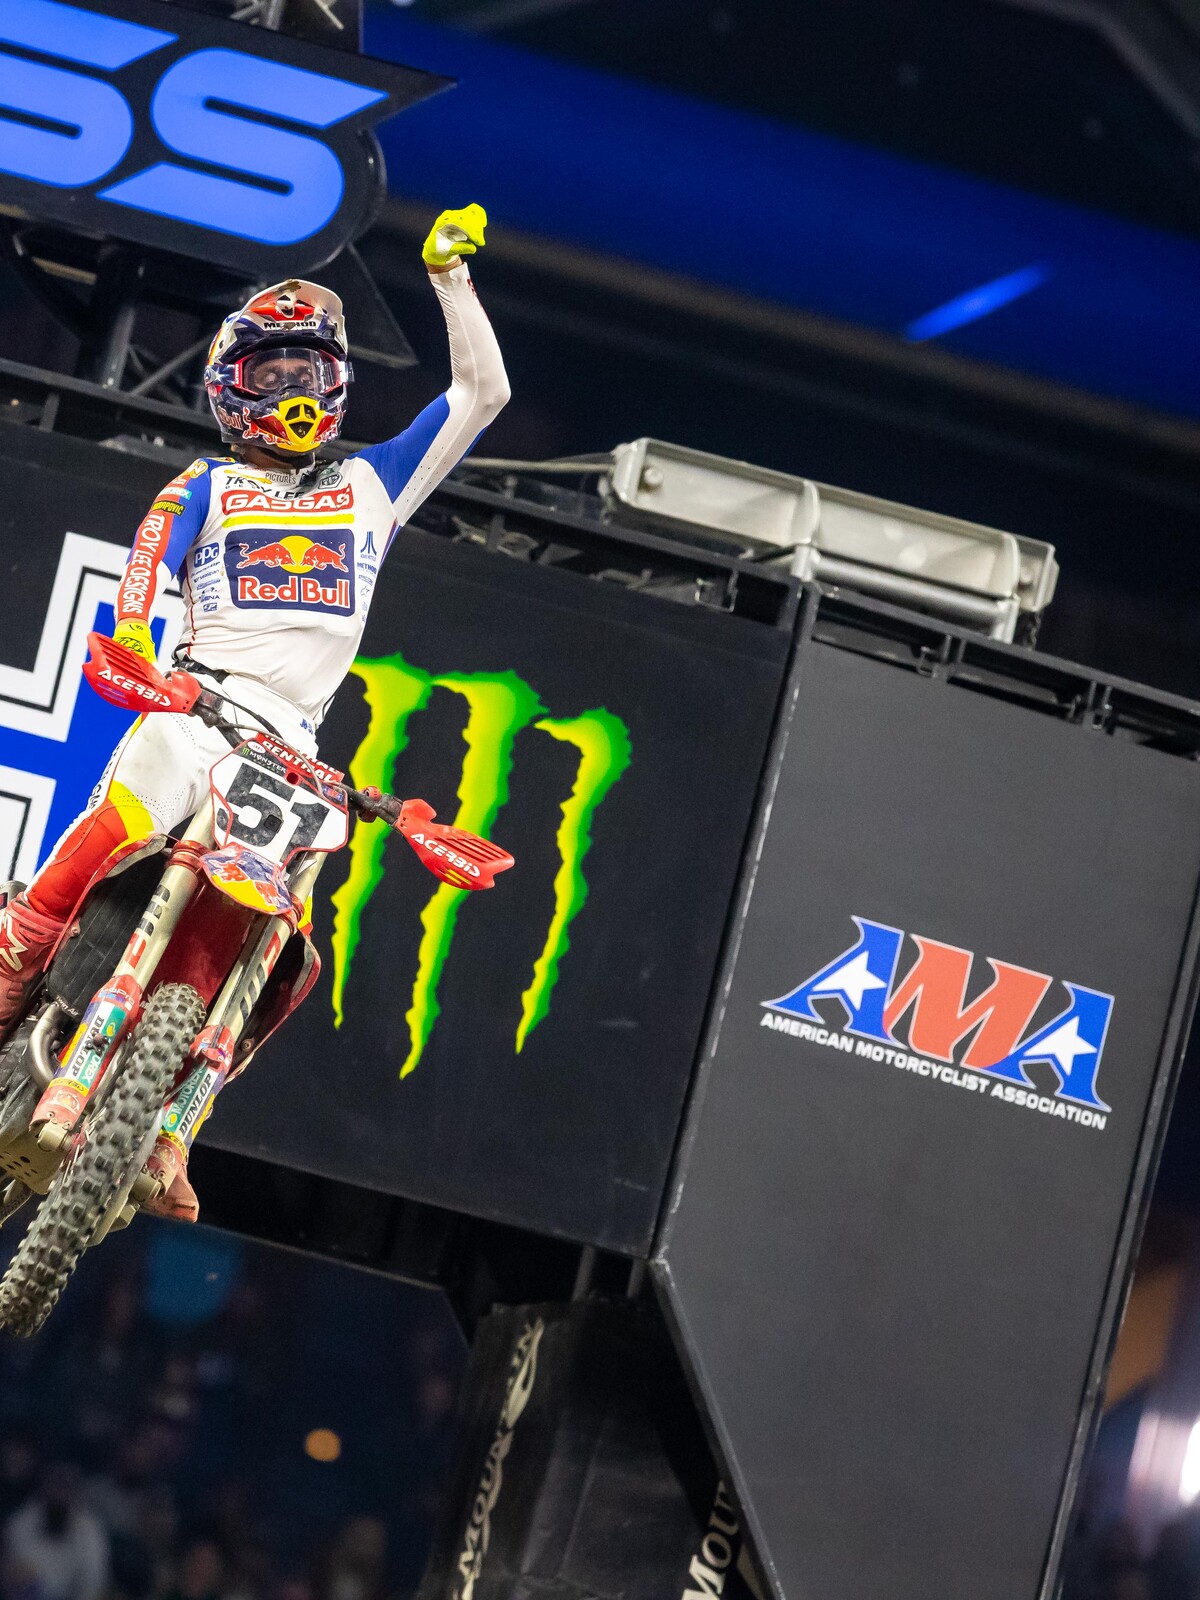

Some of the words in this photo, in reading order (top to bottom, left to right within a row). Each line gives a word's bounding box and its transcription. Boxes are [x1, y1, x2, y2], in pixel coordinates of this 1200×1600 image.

[225, 487, 351, 512] GASGAS
[139, 514, 166, 553] TROY
[131, 549, 154, 569] LEE
[195, 546, 219, 566] PPG
[122, 567, 152, 615] DESIGNS
[237, 575, 298, 603] Red
[300, 577, 352, 610] Bull
[98, 669, 172, 708] ACERBIS
[249, 751, 288, 775] MONSTER
[262, 740, 338, 783] RENTHAL
[216, 762, 331, 864] 51
[410, 832, 481, 878] ACERBIS
[55, 995, 69, 1012] Twin
[68, 1006, 79, 1017] Air
[759, 914, 1116, 1113] AMA
[759, 1011, 855, 1053] AMERICAN
[854, 1041, 990, 1094] MOTORCYCLIST
[989, 1081, 1108, 1132] ASSOCIATION
[178, 1072, 213, 1138] DUNLOP
